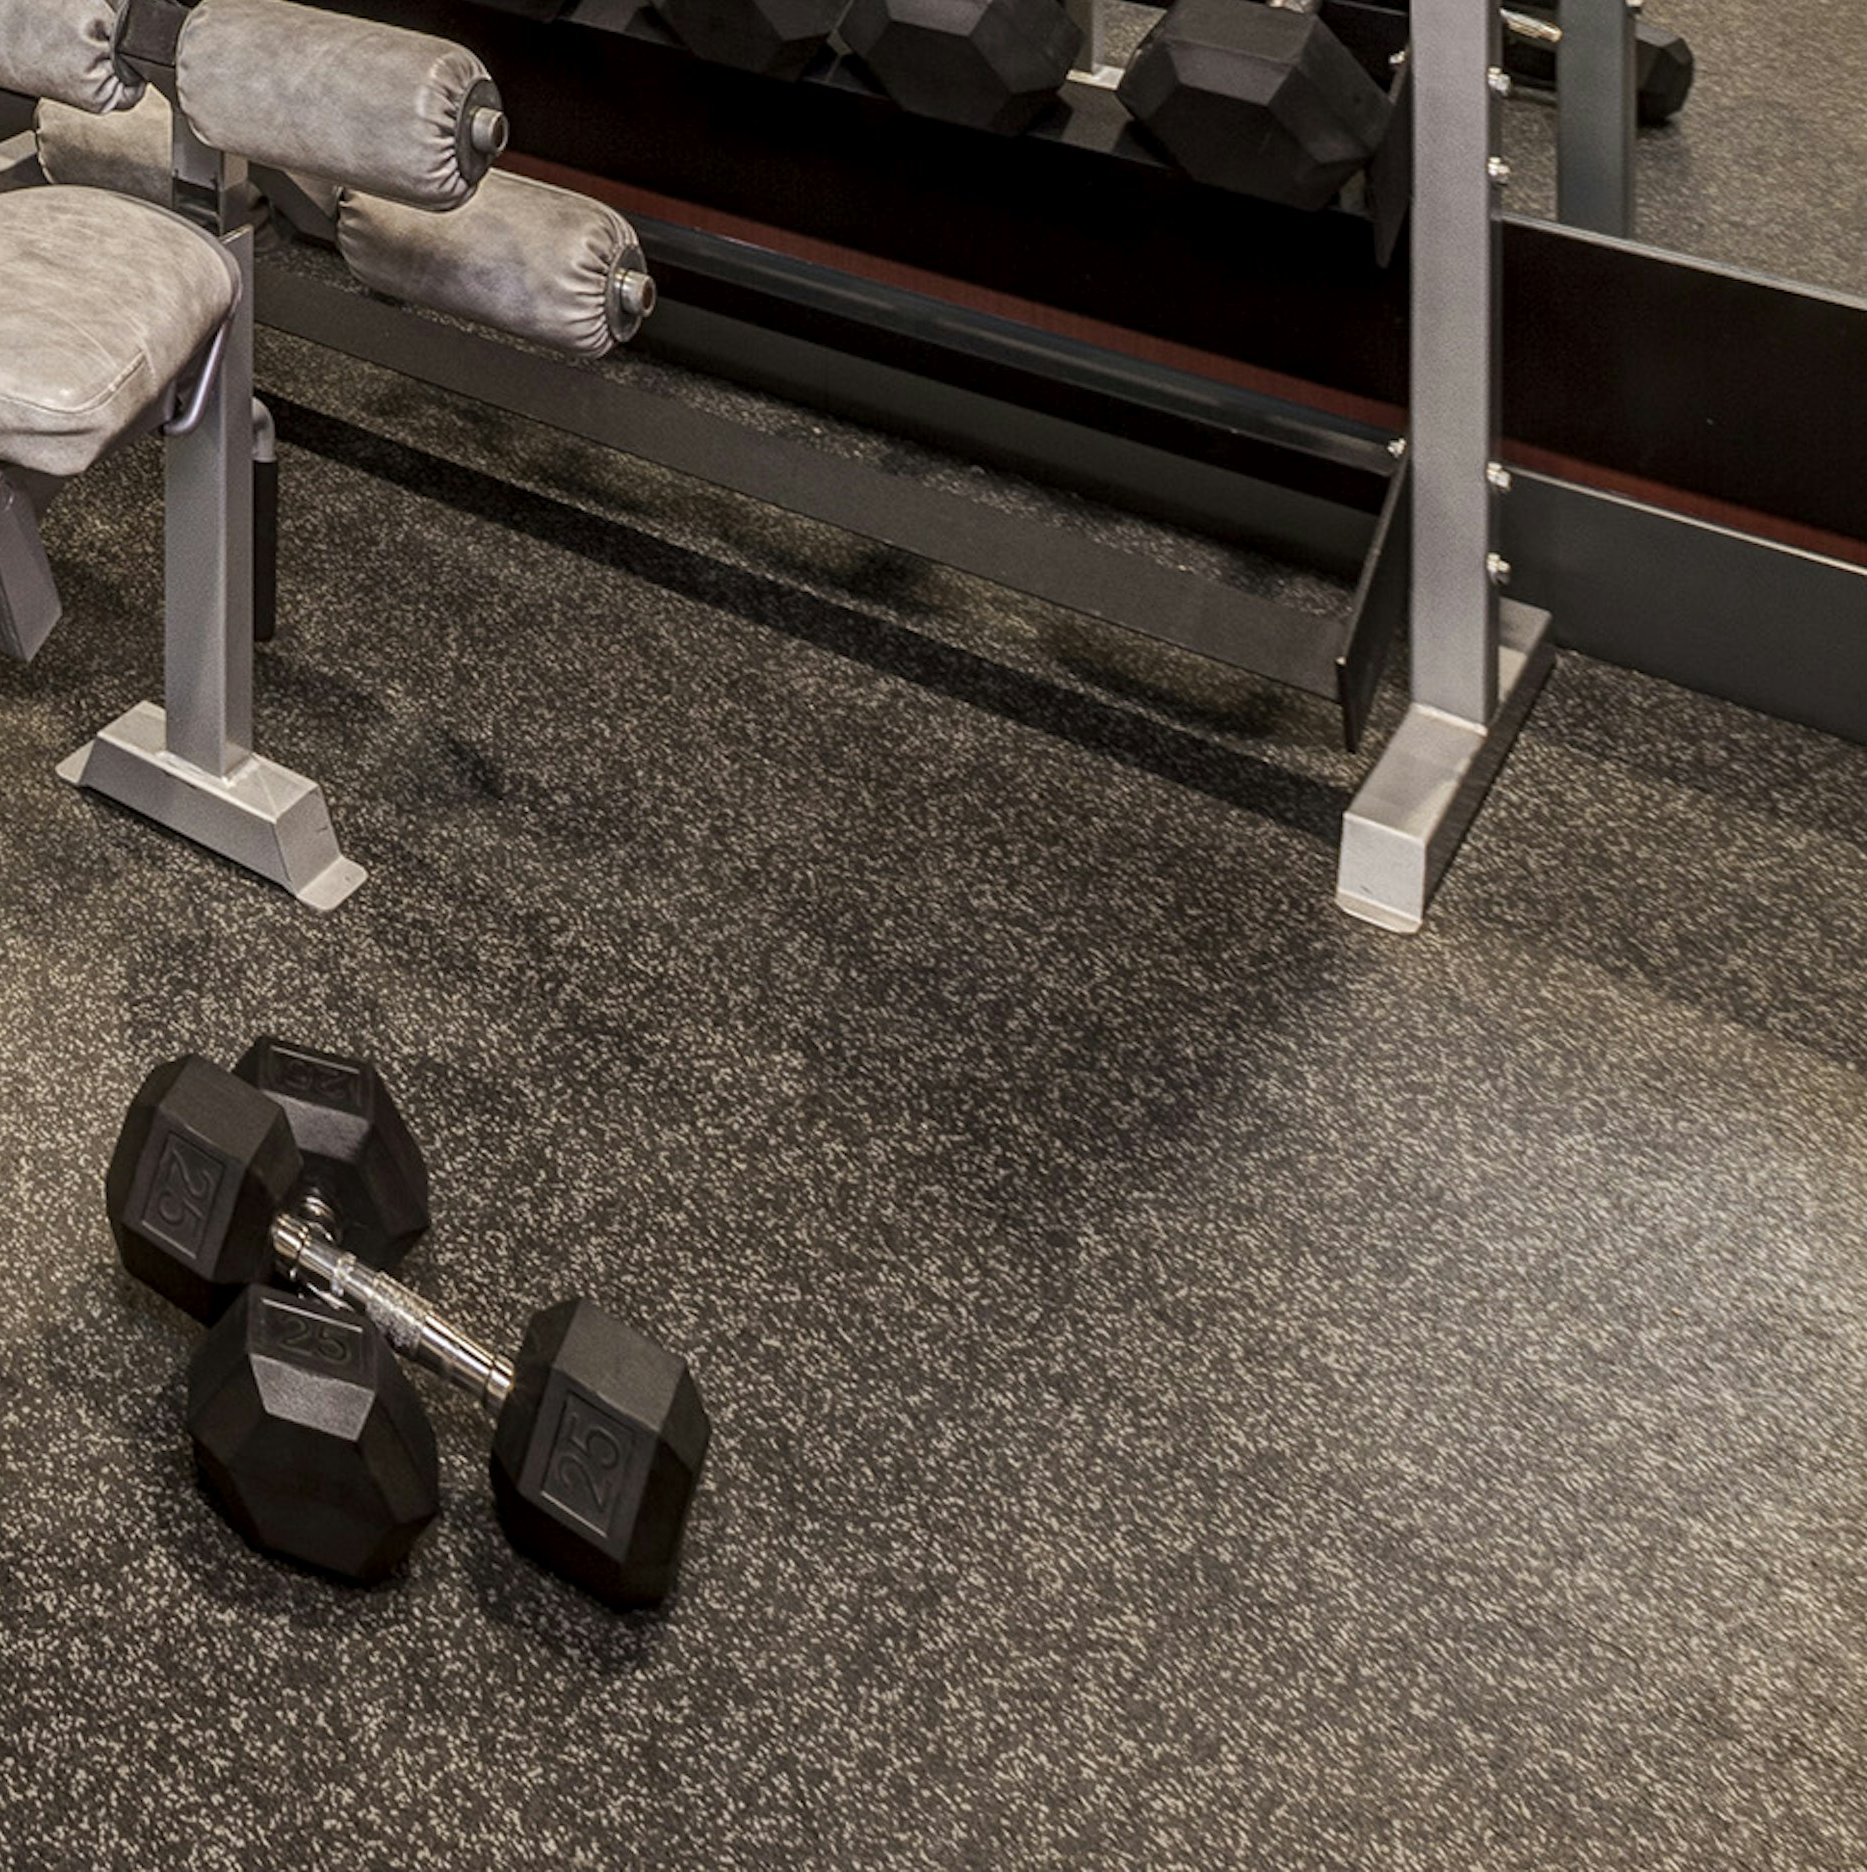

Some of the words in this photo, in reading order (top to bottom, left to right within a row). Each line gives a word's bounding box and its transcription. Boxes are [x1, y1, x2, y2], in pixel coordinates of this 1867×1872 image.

[158, 1147, 215, 1234] 25
[278, 1315, 350, 1365] 25
[557, 1411, 621, 1513] 25
